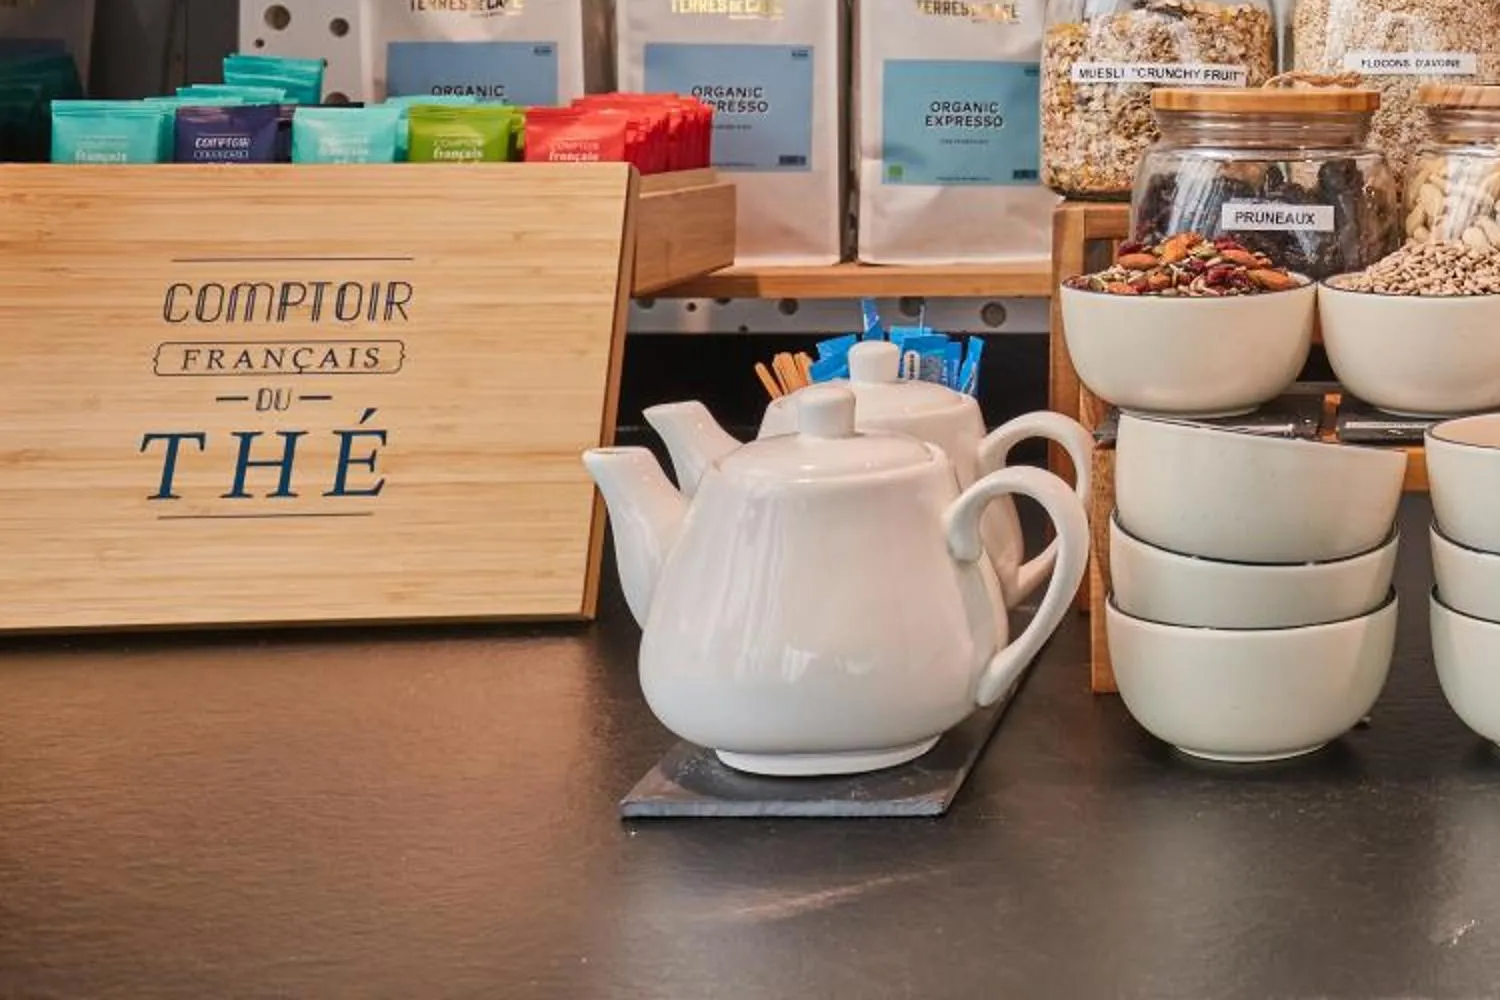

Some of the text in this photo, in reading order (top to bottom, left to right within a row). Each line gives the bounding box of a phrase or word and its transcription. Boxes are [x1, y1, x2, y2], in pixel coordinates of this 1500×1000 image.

[1079, 67, 1246, 81] MUESLI "CRUNCHY FRUIT"
[431, 84, 505, 98] ORGANIC
[691, 85, 763, 99] ORGANIC
[931, 100, 1000, 114] ORGANIC
[925, 115, 1004, 128] EXPRESSO
[1235, 211, 1316, 225] PRUNEAUX
[163, 281, 413, 323] COMPTOIR
[181, 346, 382, 374] FRANÇAIS
[255, 387, 293, 411] DU
[140, 407, 388, 500] THÉ
